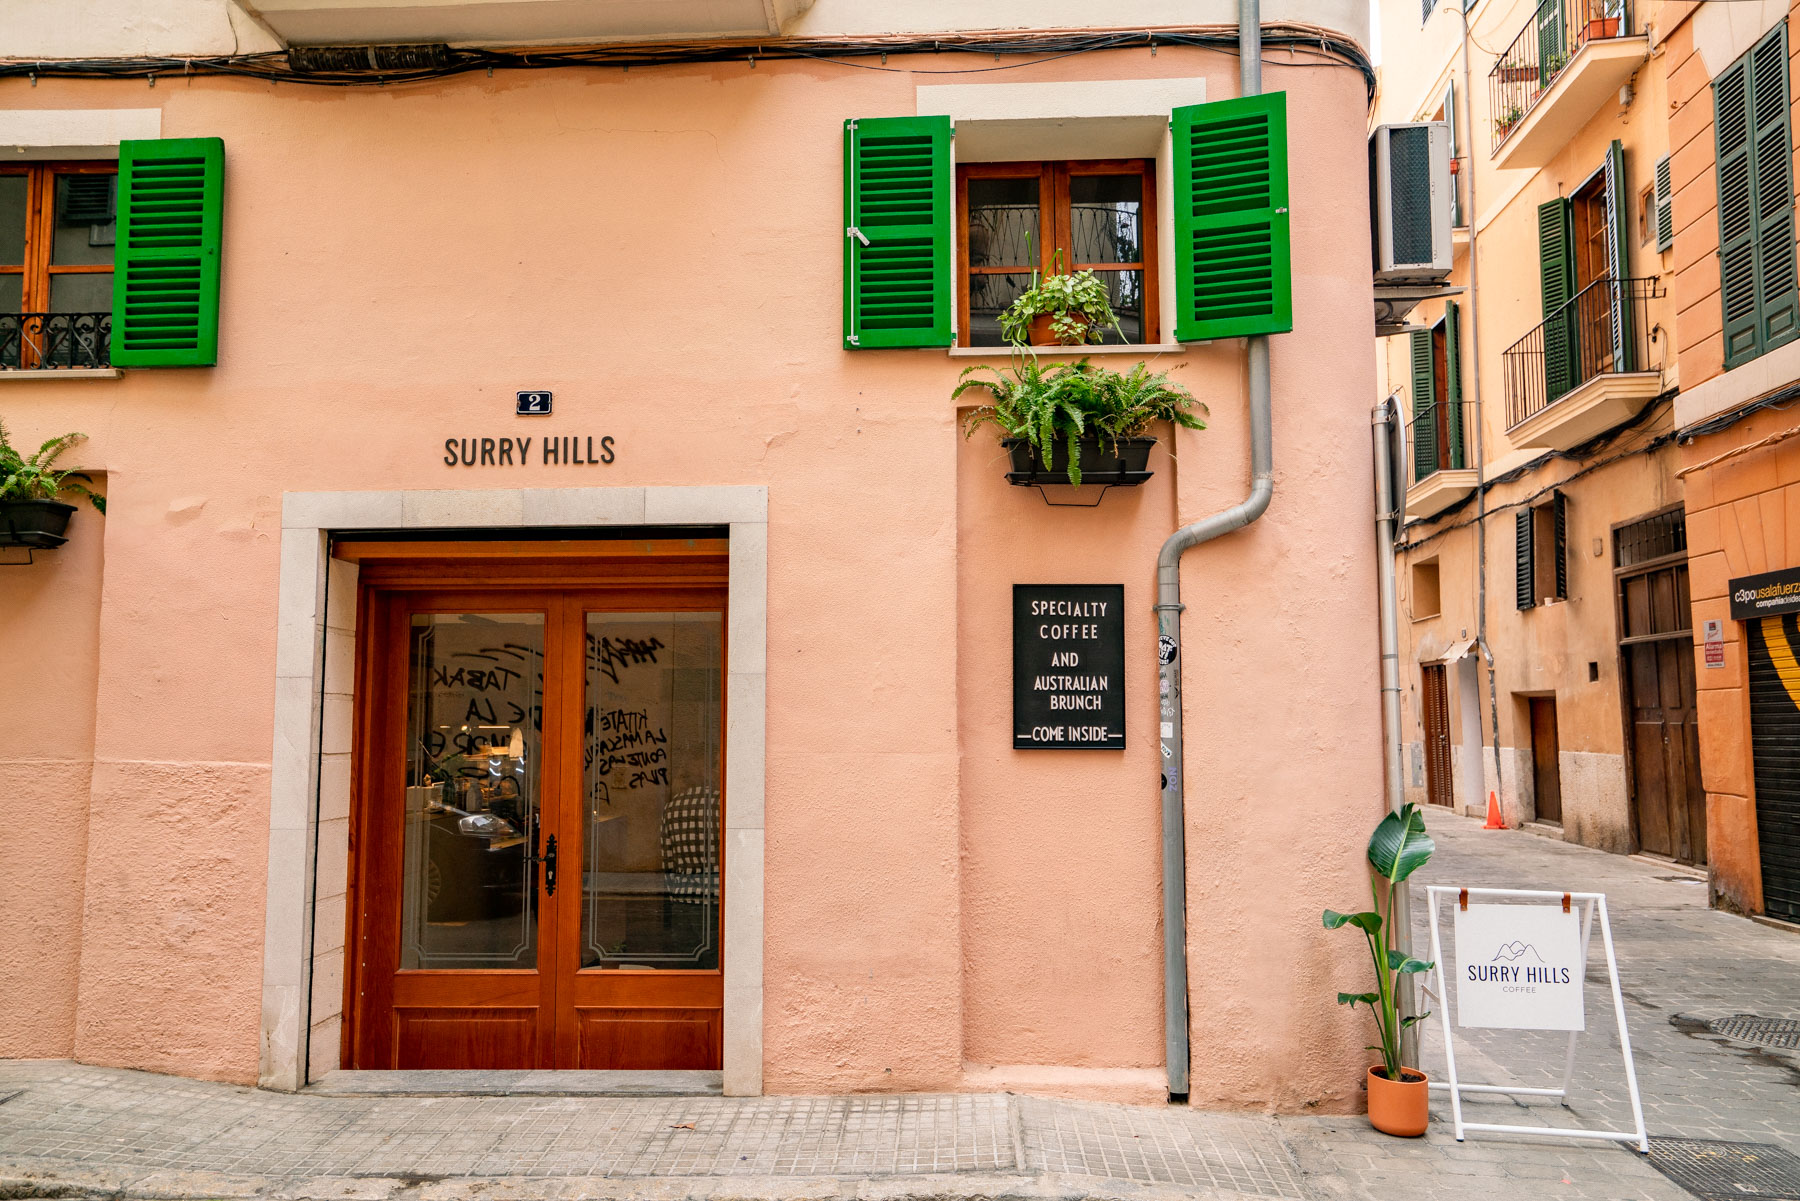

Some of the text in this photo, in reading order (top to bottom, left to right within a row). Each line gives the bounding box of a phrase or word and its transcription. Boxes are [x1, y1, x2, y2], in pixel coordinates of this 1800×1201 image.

[528, 394, 541, 411] 2
[444, 435, 615, 466] SURRY HILLS
[1031, 600, 1108, 617] SPECIALTY
[1039, 624, 1098, 640] COFFEE
[1051, 651, 1079, 668] AND
[1033, 675, 1108, 692] AUSTRALIAN
[1050, 695, 1102, 711] BRUNCH
[1468, 965, 1570, 984] SURRY HILLS
[1502, 986, 1536, 994] COFFEE
